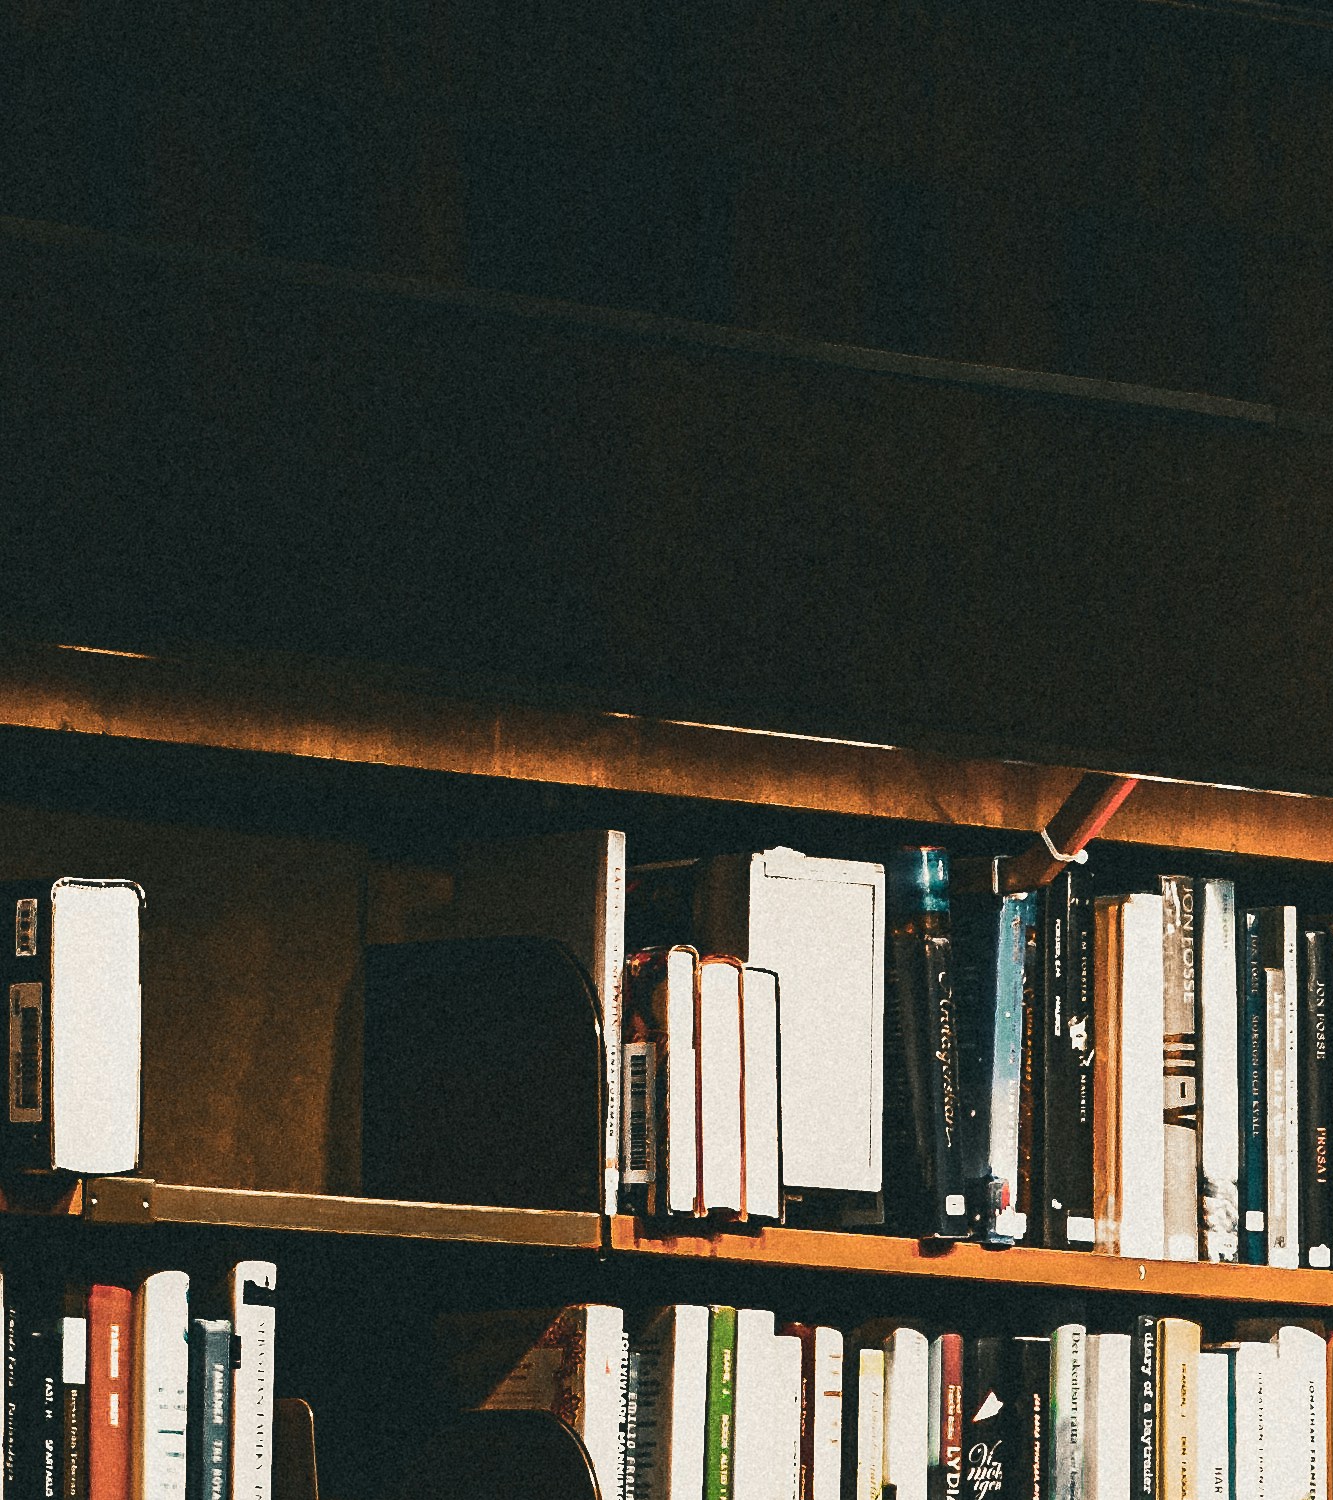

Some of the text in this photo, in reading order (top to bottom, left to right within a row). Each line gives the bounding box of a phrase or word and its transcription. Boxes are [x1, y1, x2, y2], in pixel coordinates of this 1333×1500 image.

[1183, 886, 1196, 1003] JON FOSSE
[1316, 980, 1327, 1173] JON FOSSE PROSA
[1142, 1332, 1153, 1377] diary
[1143, 1381, 1153, 1397] of
[1142, 1419, 1153, 1494] Daytrader
